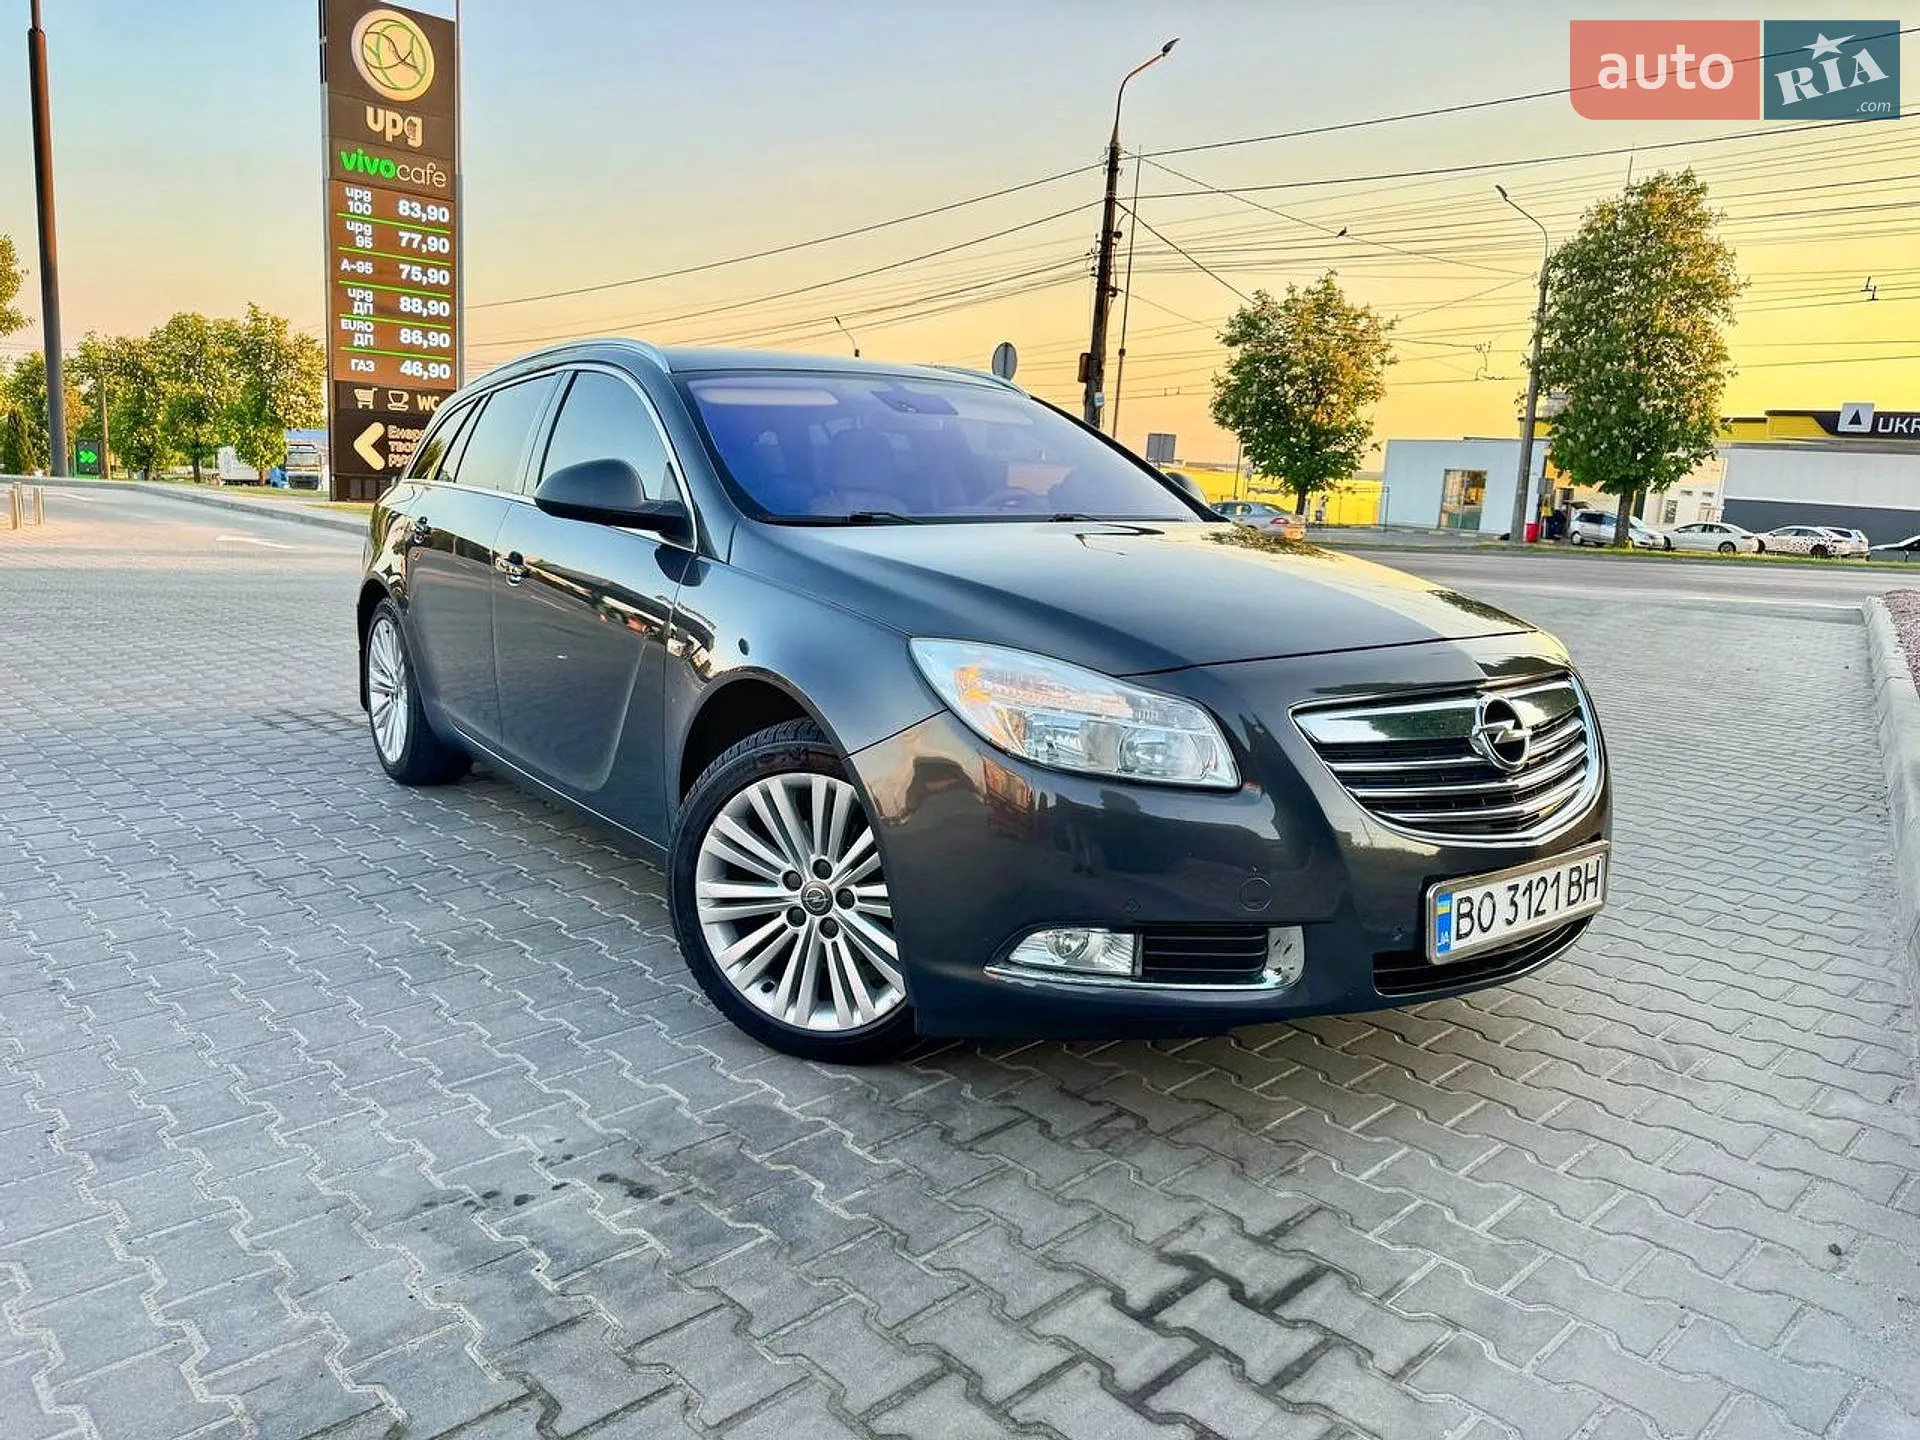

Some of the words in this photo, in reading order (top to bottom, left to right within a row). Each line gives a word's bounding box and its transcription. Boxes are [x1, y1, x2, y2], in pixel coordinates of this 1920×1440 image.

[365, 105, 423, 148] upg
[340, 148, 447, 189] vivocafe
[345, 187, 372, 203] upg
[347, 201, 372, 215] 100
[398, 199, 450, 223] 83,90
[346, 220, 372, 236] upg
[355, 235, 373, 249] 95
[398, 231, 450, 254] 77,90
[399, 264, 450, 286] 75,90
[347, 287, 373, 302] upg
[352, 301, 374, 316] ДП
[399, 296, 450, 318] 88,90
[340, 318, 374, 332] EURO
[353, 333, 374, 347] ДП
[399, 328, 451, 349] 86,90
[350, 359, 375, 372] ГАЗ
[399, 360, 451, 380] 46,90
[416, 394, 440, 412] WC
[1456, 891, 1496, 941] BO
[1504, 871, 1561, 926] 3121
[1567, 859, 1600, 906] BH
